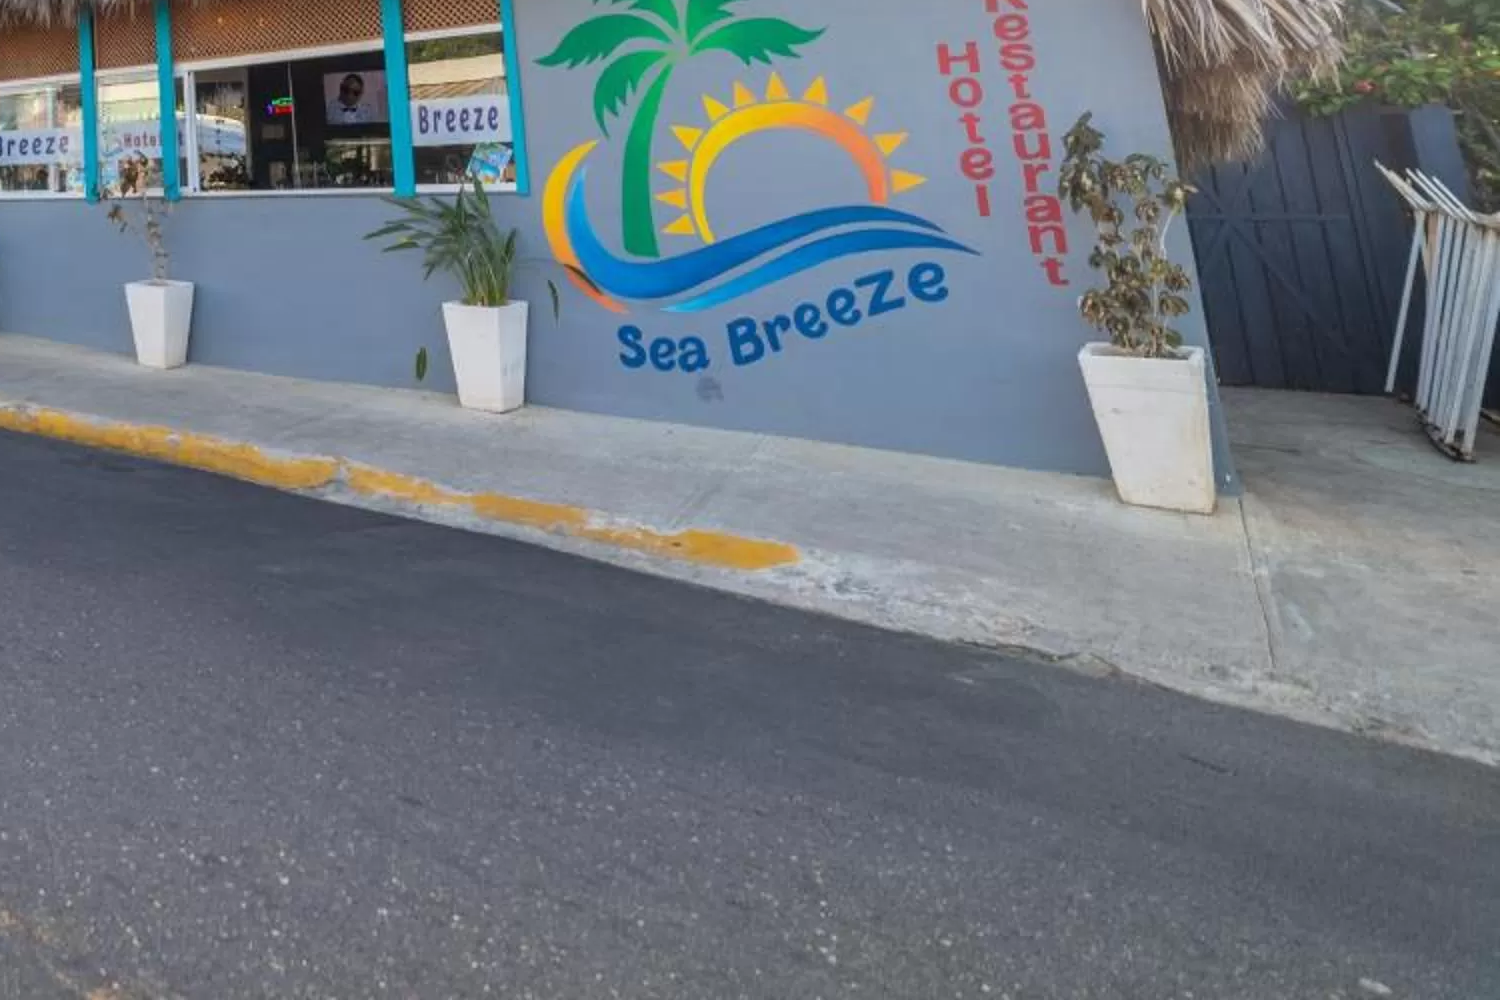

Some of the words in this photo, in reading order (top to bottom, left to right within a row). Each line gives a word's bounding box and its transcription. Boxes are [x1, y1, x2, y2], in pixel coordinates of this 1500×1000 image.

[418, 104, 499, 134] Breeze
[935, 40, 995, 217] Hotel
[617, 324, 711, 373] Sea
[726, 261, 949, 366] Breeze
